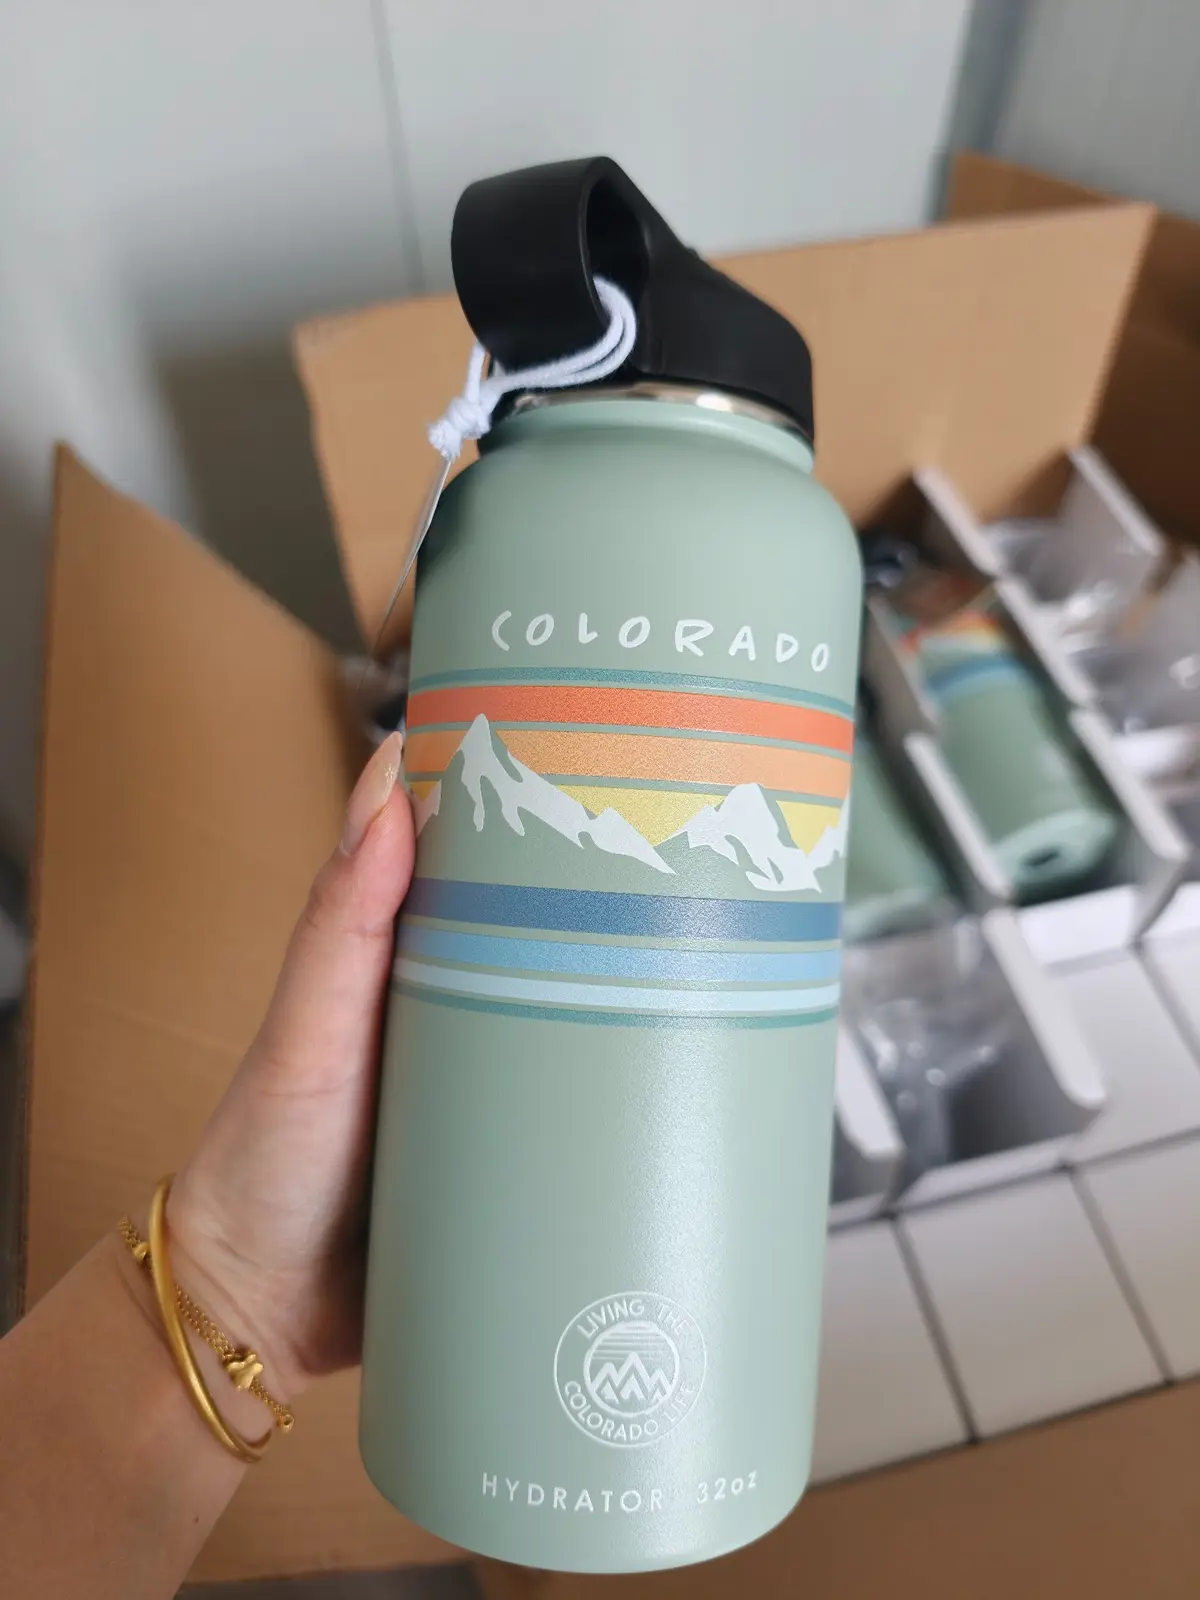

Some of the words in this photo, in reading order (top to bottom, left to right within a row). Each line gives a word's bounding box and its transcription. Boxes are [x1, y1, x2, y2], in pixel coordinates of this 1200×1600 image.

[491, 610, 830, 673] COLORADO
[576, 1298, 645, 1339] LIVING
[656, 1303, 690, 1337] THE
[564, 1380, 659, 1441] COLORADO
[664, 1377, 696, 1422] LIFE
[482, 1472, 663, 1513] HYDRATOR
[696, 1470, 758, 1504] 32oz
